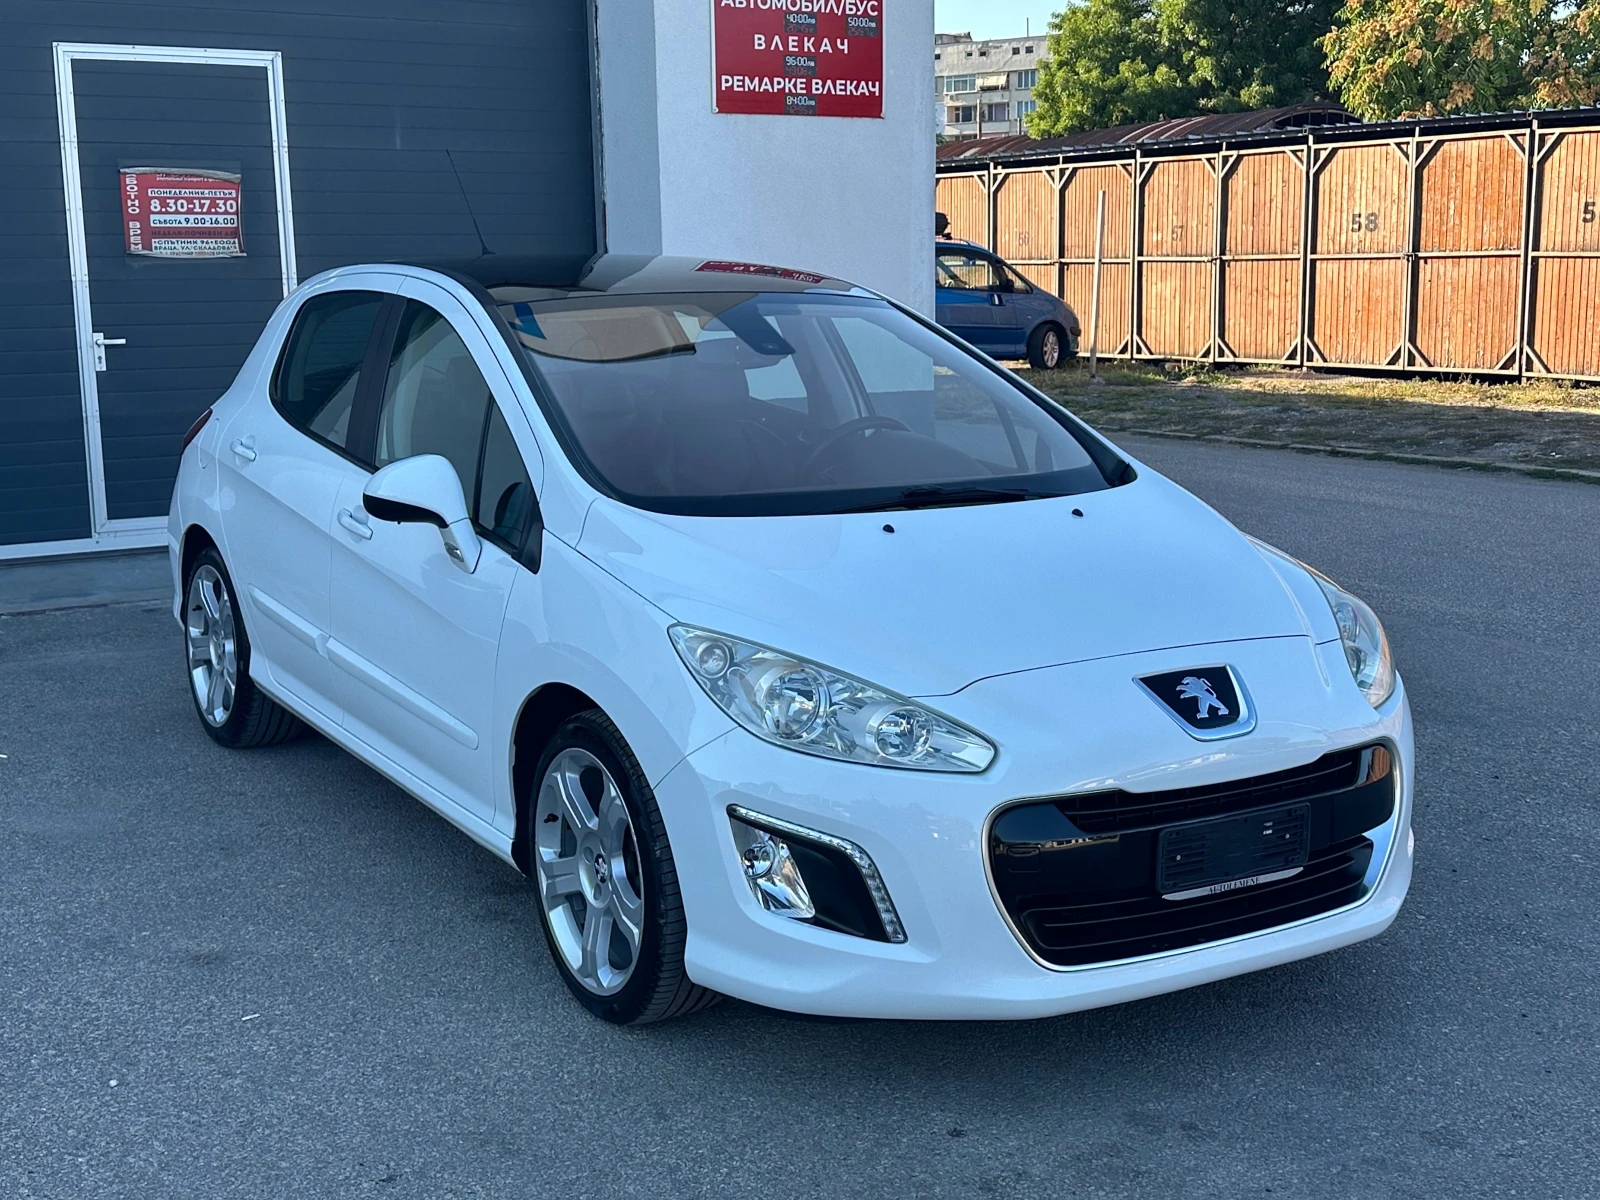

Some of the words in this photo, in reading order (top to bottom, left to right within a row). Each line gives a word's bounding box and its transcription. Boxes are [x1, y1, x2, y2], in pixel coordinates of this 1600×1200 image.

[754, 34, 848, 54] ВЛЕКАЧ
[721, 75, 807, 94] РЕМАРКЕ
[811, 78, 879, 96] ВЛЕКАЧ
[150, 189, 234, 197] ПОНЕДЕЛНИК-ПЕТЪК
[150, 198, 237, 213] 8.30-17.30
[184, 217, 235, 225] 9.00-16.00
[1351, 212, 1379, 233] 58
